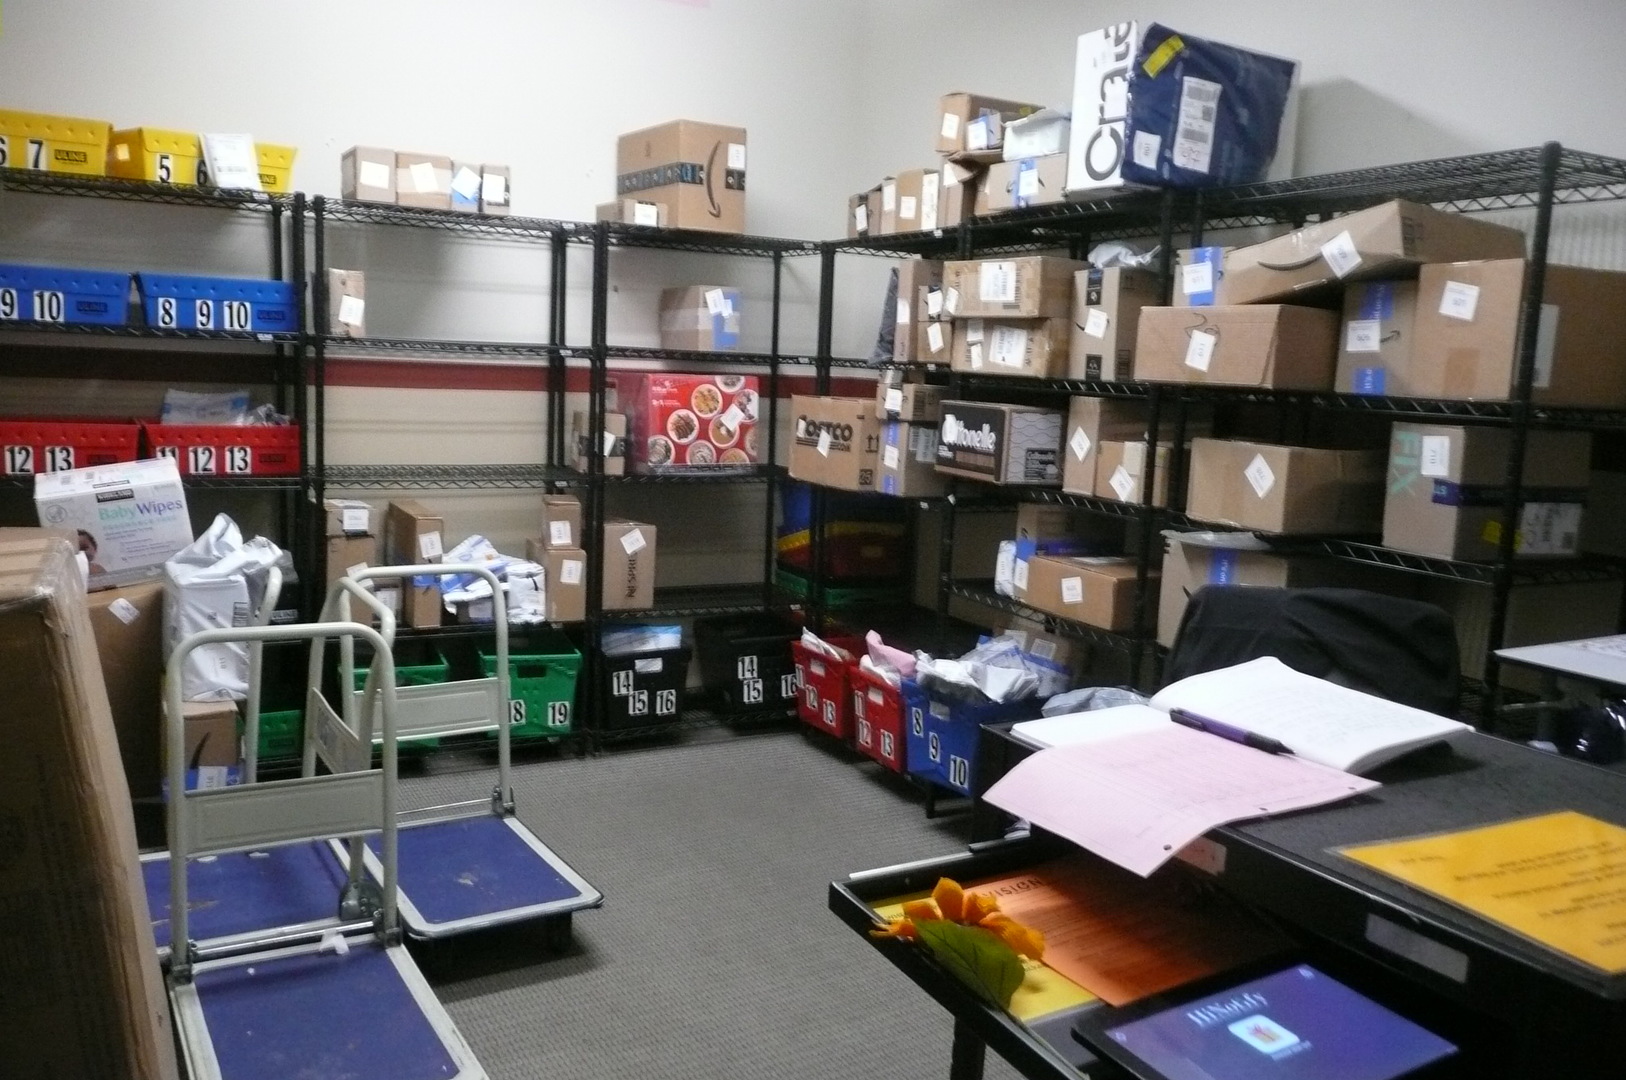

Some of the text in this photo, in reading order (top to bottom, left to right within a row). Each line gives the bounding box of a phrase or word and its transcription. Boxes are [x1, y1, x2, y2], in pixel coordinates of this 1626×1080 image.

[29, 139, 43, 168] 7
[55, 150, 87, 161] ULINE
[159, 154, 170, 183] 5
[2, 289, 60, 321] 9 10
[162, 299, 248, 328] 8 9 10
[942, 414, 996, 449] ttonelle
[6, 446, 30, 473] 12
[47, 447, 71, 472] 13
[189, 447, 213, 472] 12
[227, 447, 248, 471] 13
[99, 500, 182, 520] Baby Wipes
[739, 656, 755, 678] 14
[614, 671, 631, 694] 14
[744, 680, 761, 700] 15
[782, 674, 797, 696] 16
[549, 703, 568, 725] 19
[629, 690, 673, 713] 15 16
[914, 709, 922, 735] 8
[881, 732, 894, 758] 13
[931, 734, 938, 760] 9
[951, 756, 967, 786] 10
